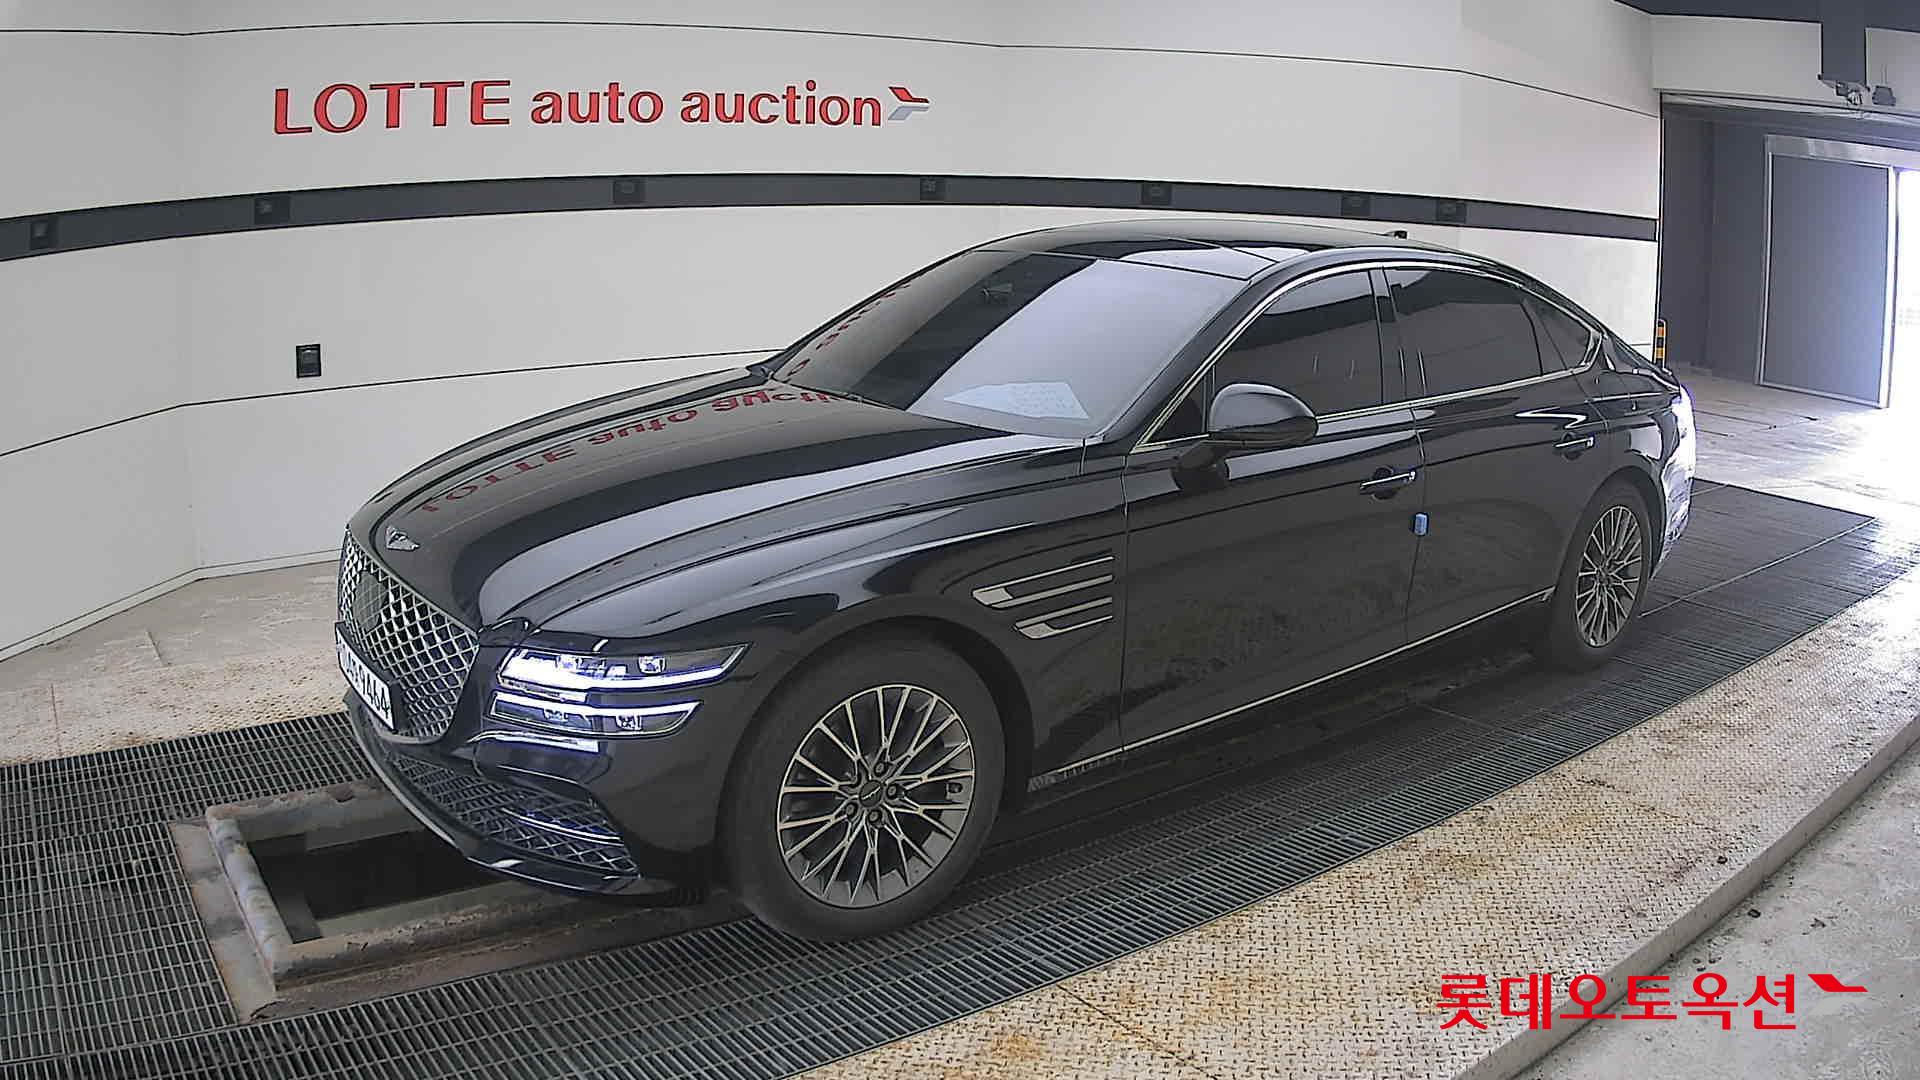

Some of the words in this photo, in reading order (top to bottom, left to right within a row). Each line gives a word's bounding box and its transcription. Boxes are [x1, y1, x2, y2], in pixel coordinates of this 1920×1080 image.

[273, 79, 511, 135] LOTTE
[530, 81, 665, 125] auto
[680, 79, 882, 127] auction
